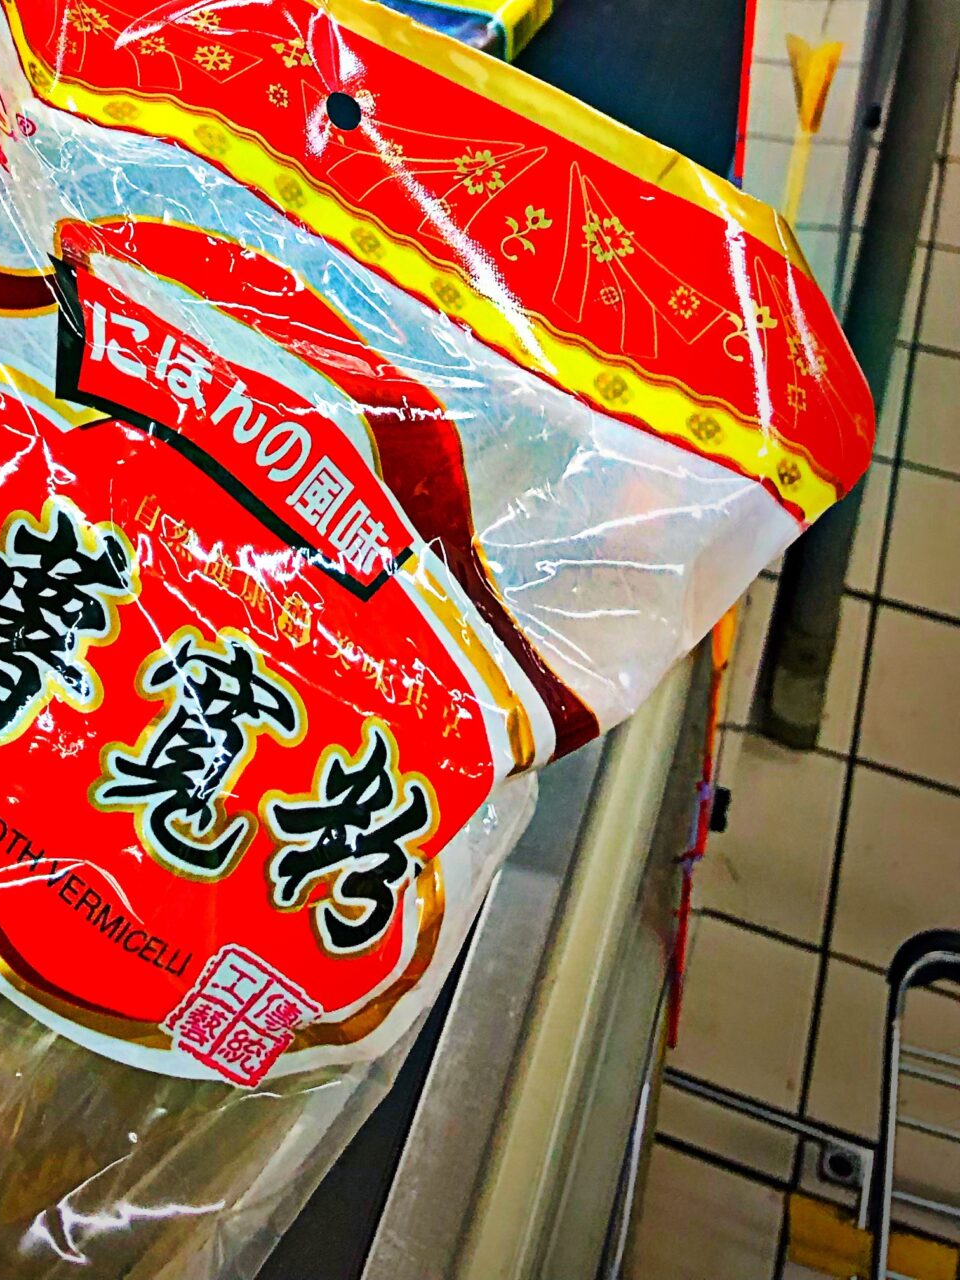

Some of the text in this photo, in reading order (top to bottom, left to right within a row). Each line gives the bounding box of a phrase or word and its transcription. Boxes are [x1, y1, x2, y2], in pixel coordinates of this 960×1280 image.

[83, 300, 390, 577] にほんの風味
[43, 859, 194, 979] VERMICELLI
